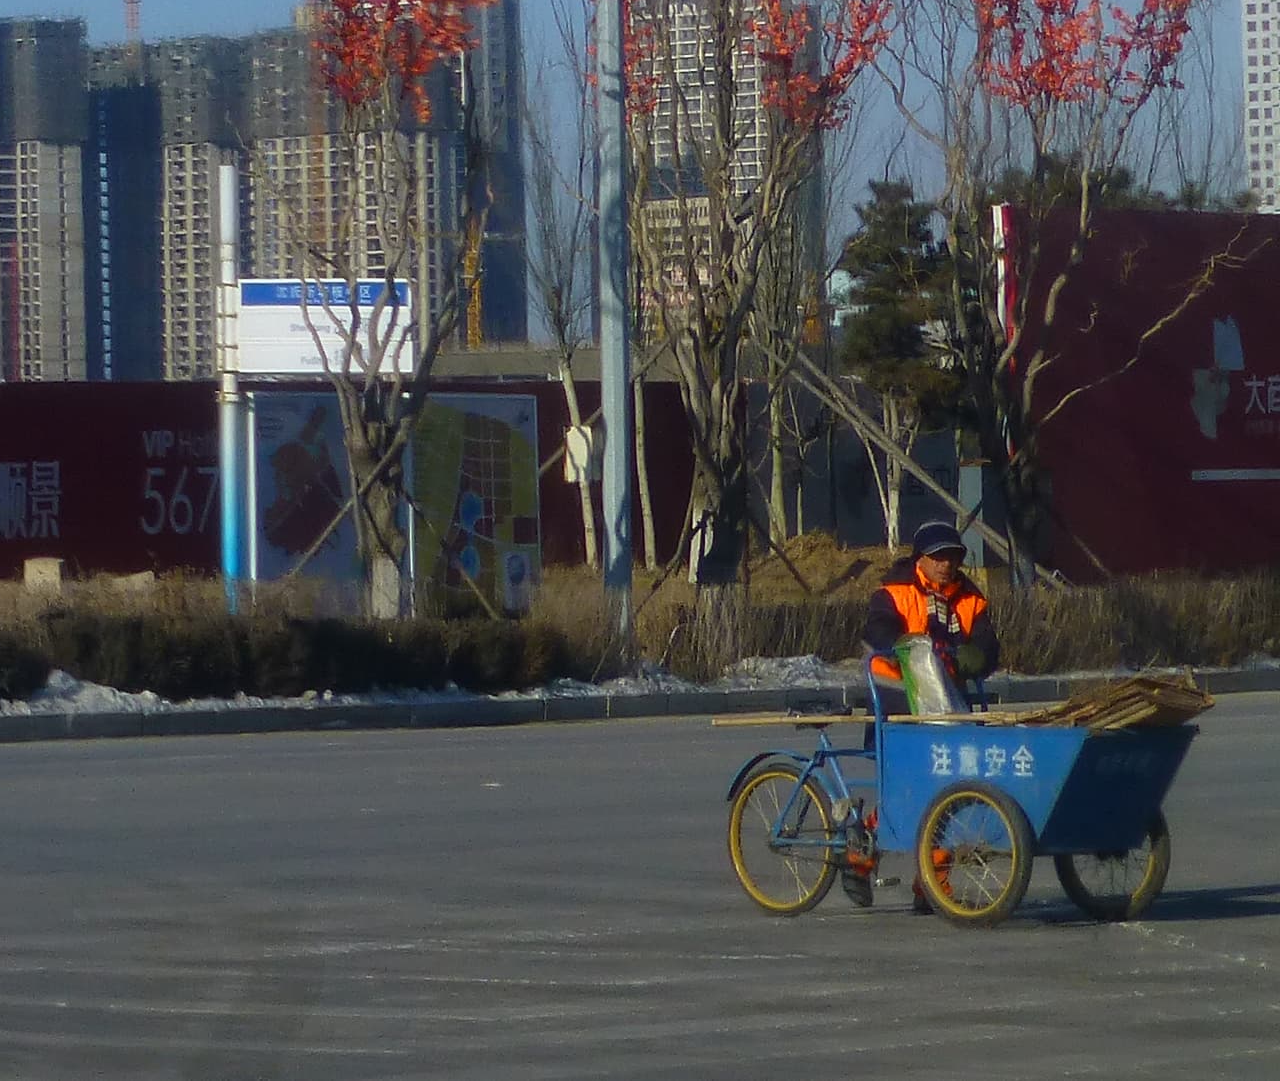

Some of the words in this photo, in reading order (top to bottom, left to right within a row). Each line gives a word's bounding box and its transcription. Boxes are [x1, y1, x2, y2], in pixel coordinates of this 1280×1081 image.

[142, 430, 174, 457] VIP
[930, 743, 1034, 777] 注意安全
